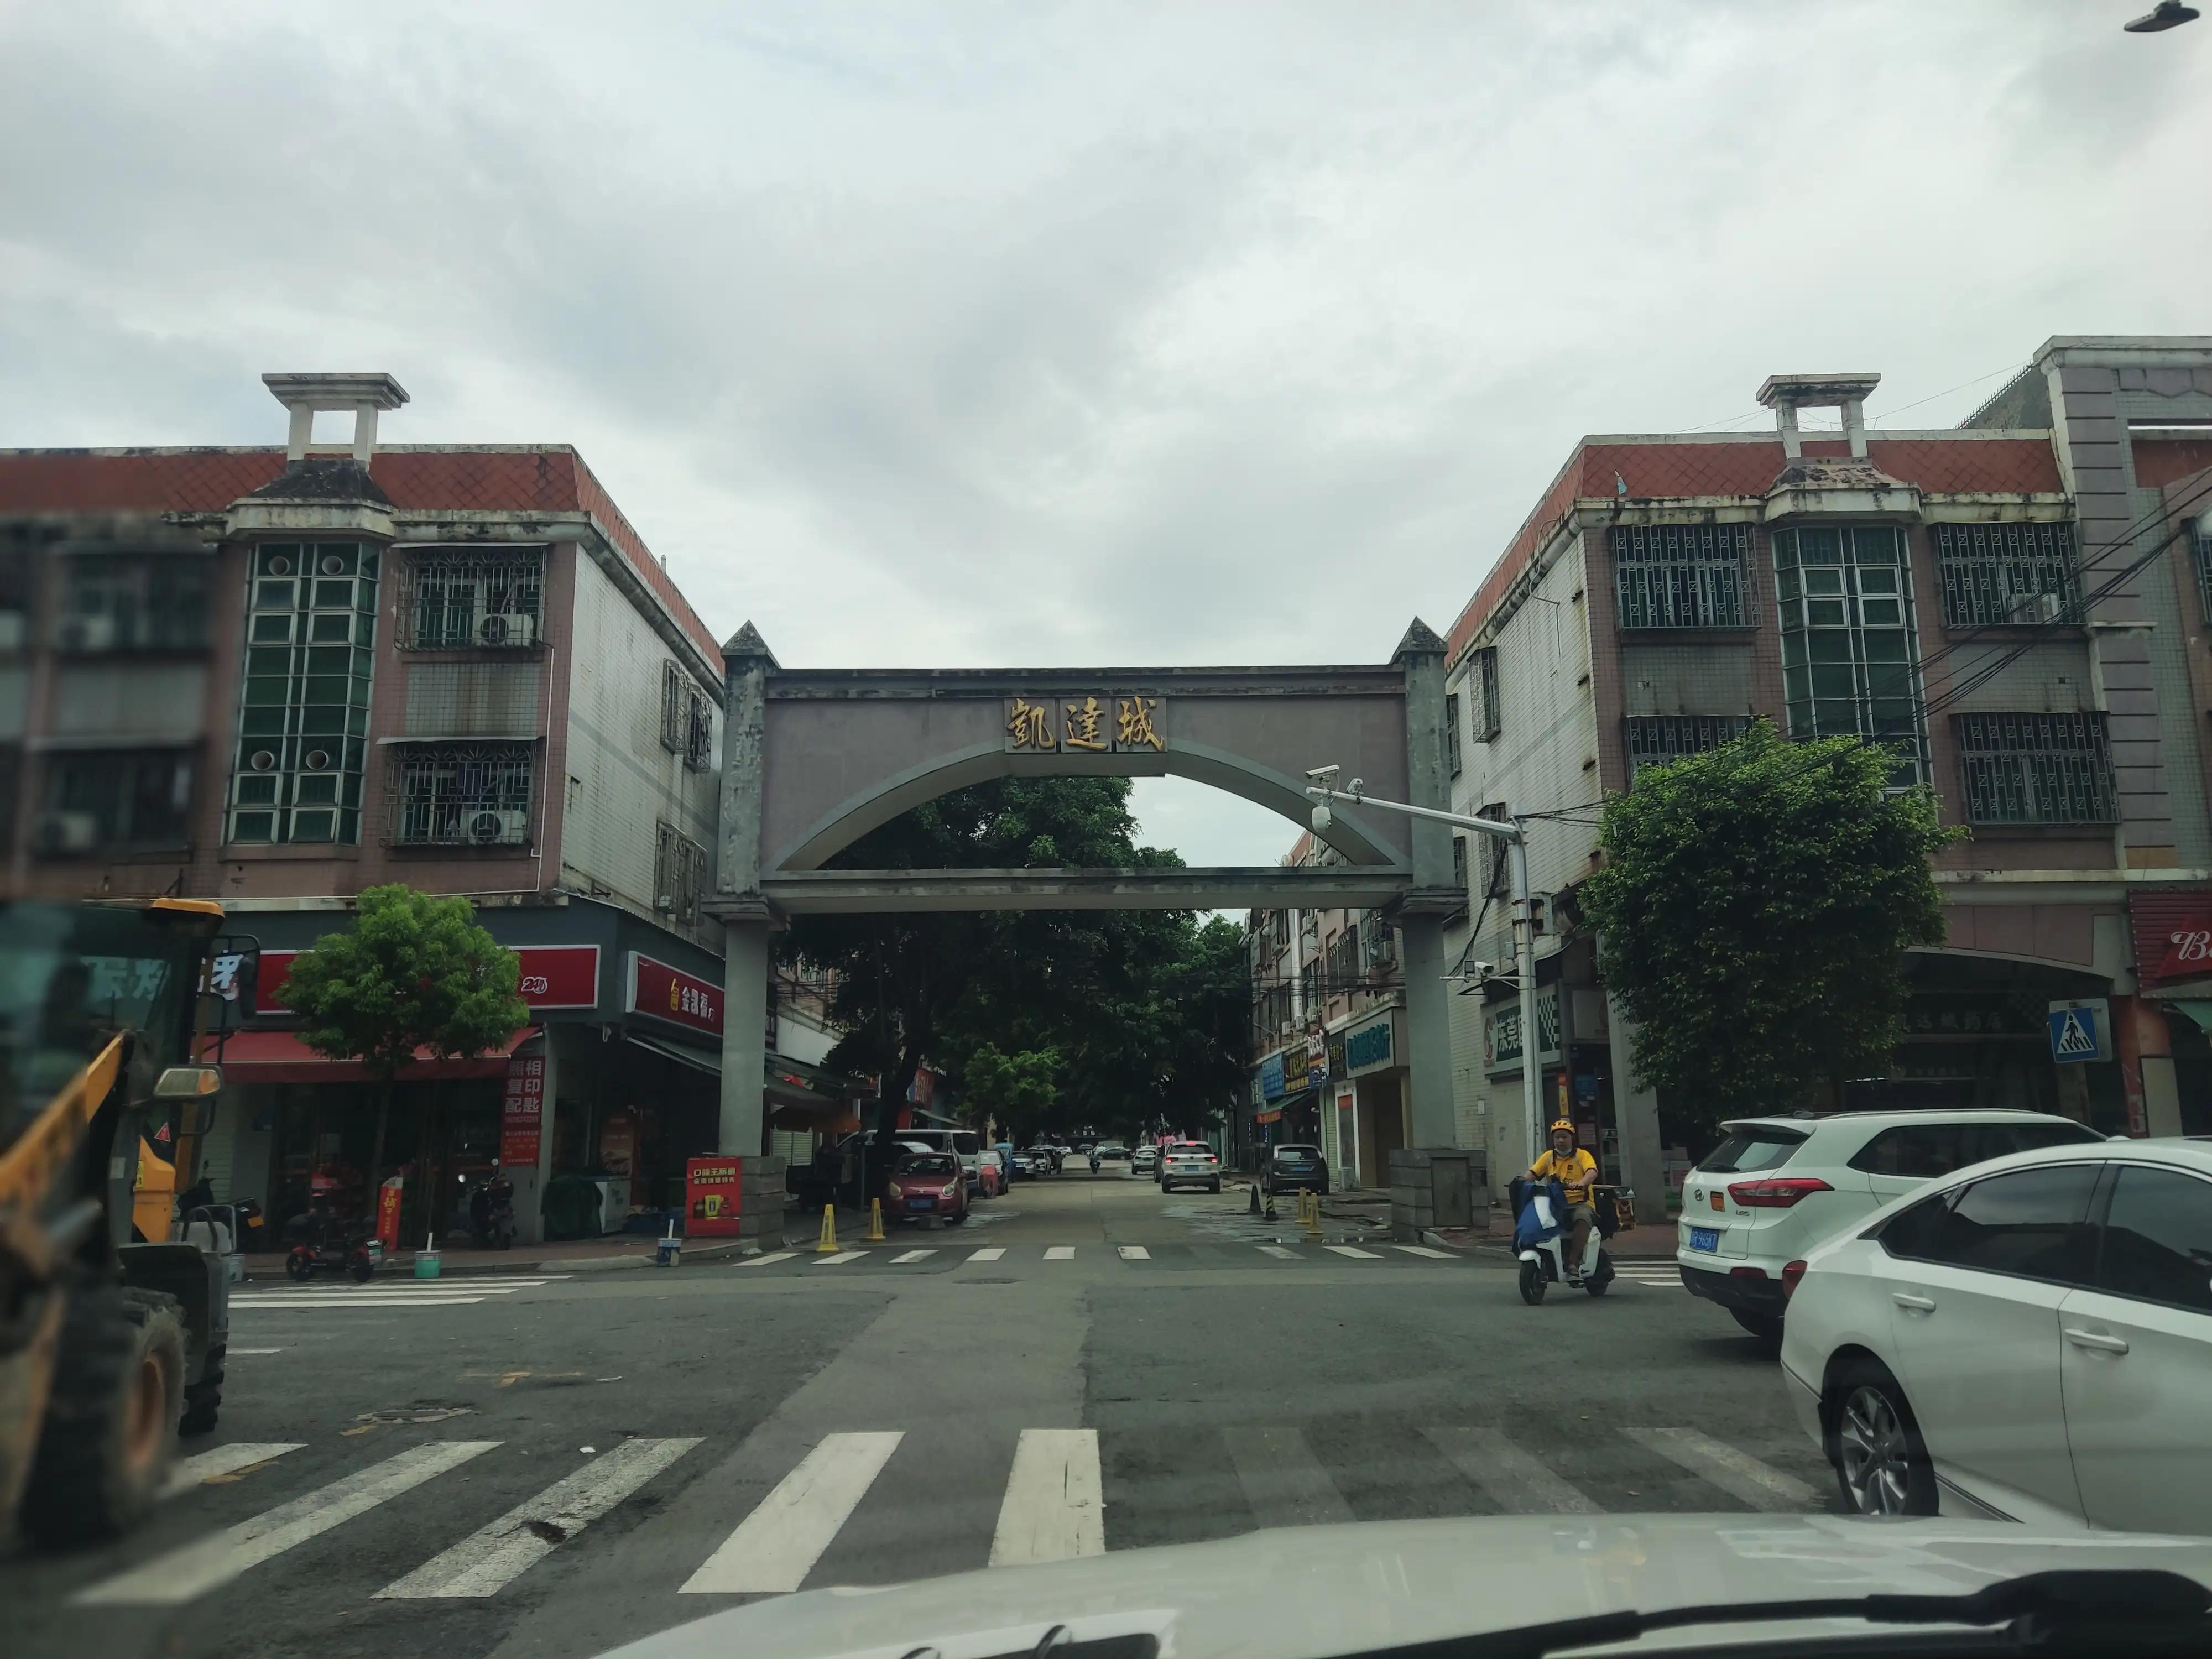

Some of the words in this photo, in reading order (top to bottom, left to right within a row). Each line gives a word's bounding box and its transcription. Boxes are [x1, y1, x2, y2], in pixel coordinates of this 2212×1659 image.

[1006, 696, 1166, 752] 凱達城
[2171, 931, 2212, 961] B
[509, 1060, 542, 1076] 照相
[507, 1078, 540, 1095] 复印
[505, 1097, 540, 1113] 配匙
